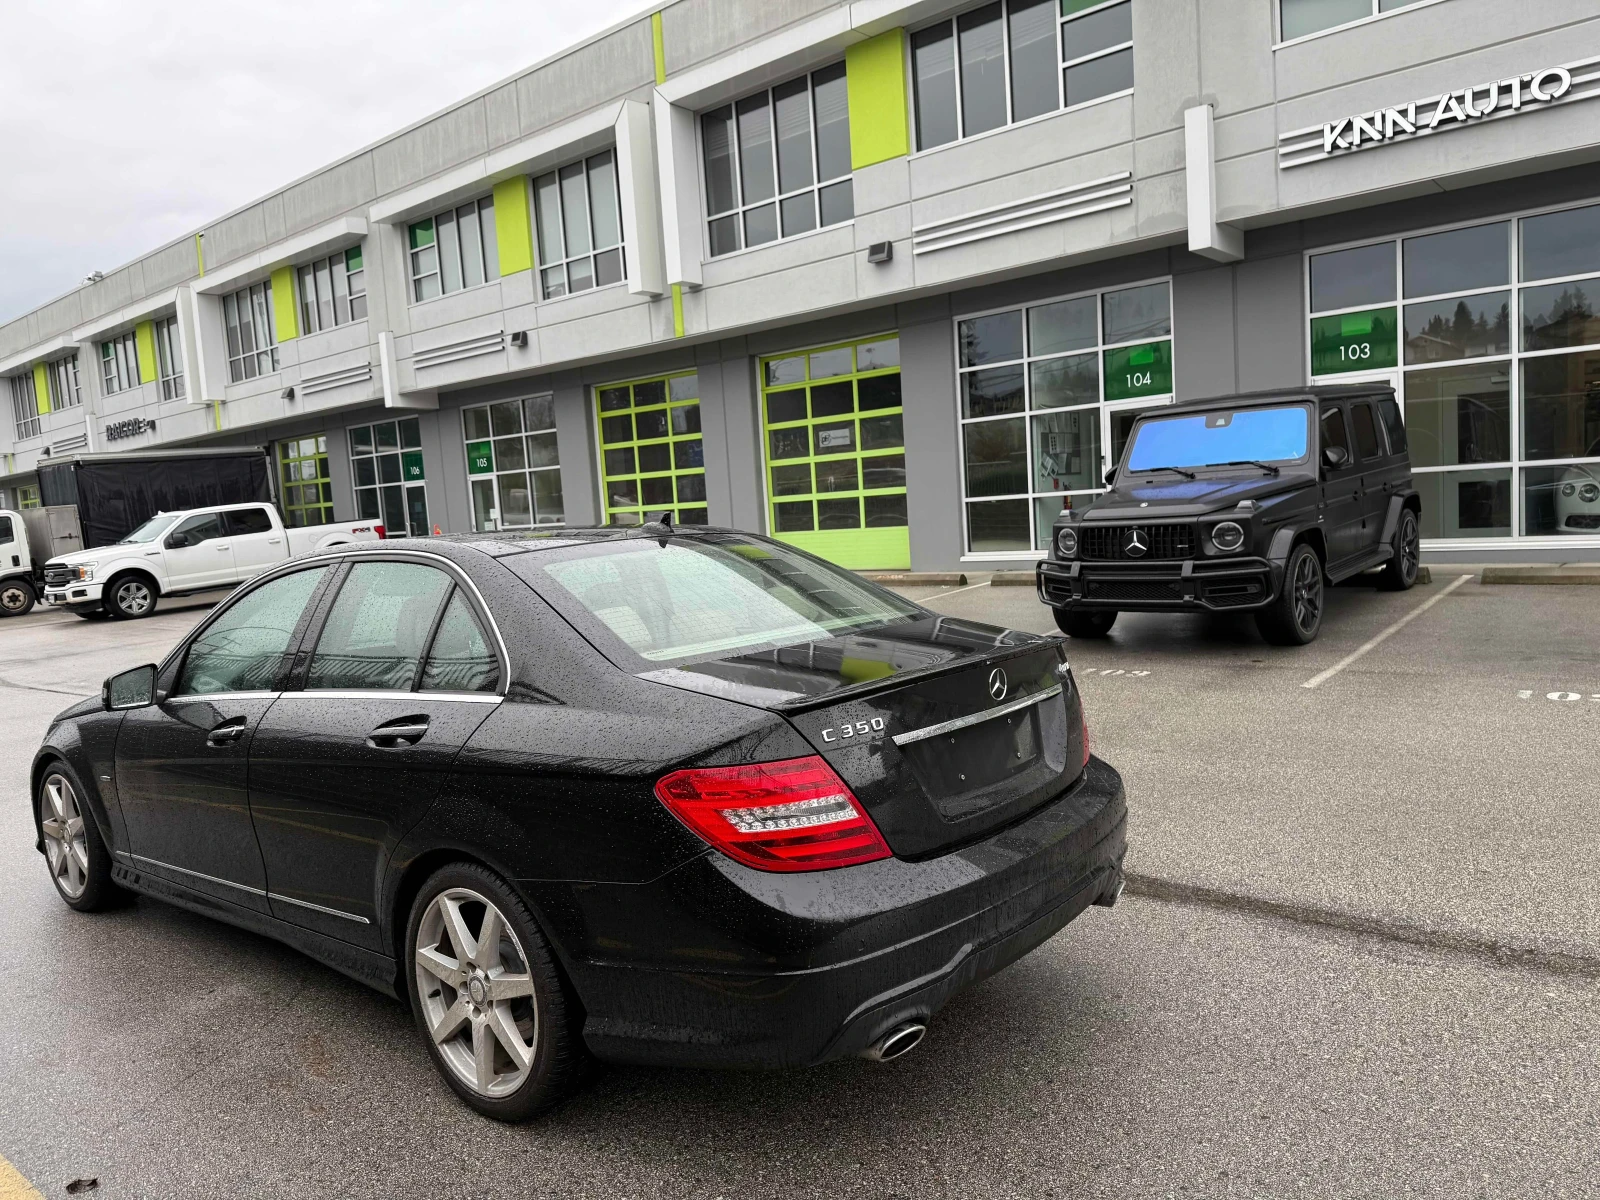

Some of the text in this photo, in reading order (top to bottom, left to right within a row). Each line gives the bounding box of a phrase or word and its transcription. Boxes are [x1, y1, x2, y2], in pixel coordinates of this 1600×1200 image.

[1322, 66, 1573, 152] KNN AUTO
[1339, 342, 1371, 361] 103
[1126, 370, 1152, 388] 104
[410, 466, 420, 475] 106
[476, 458, 487, 467] 105
[1516, 689, 1600, 702] 10
[821, 717, 884, 742] C 350
